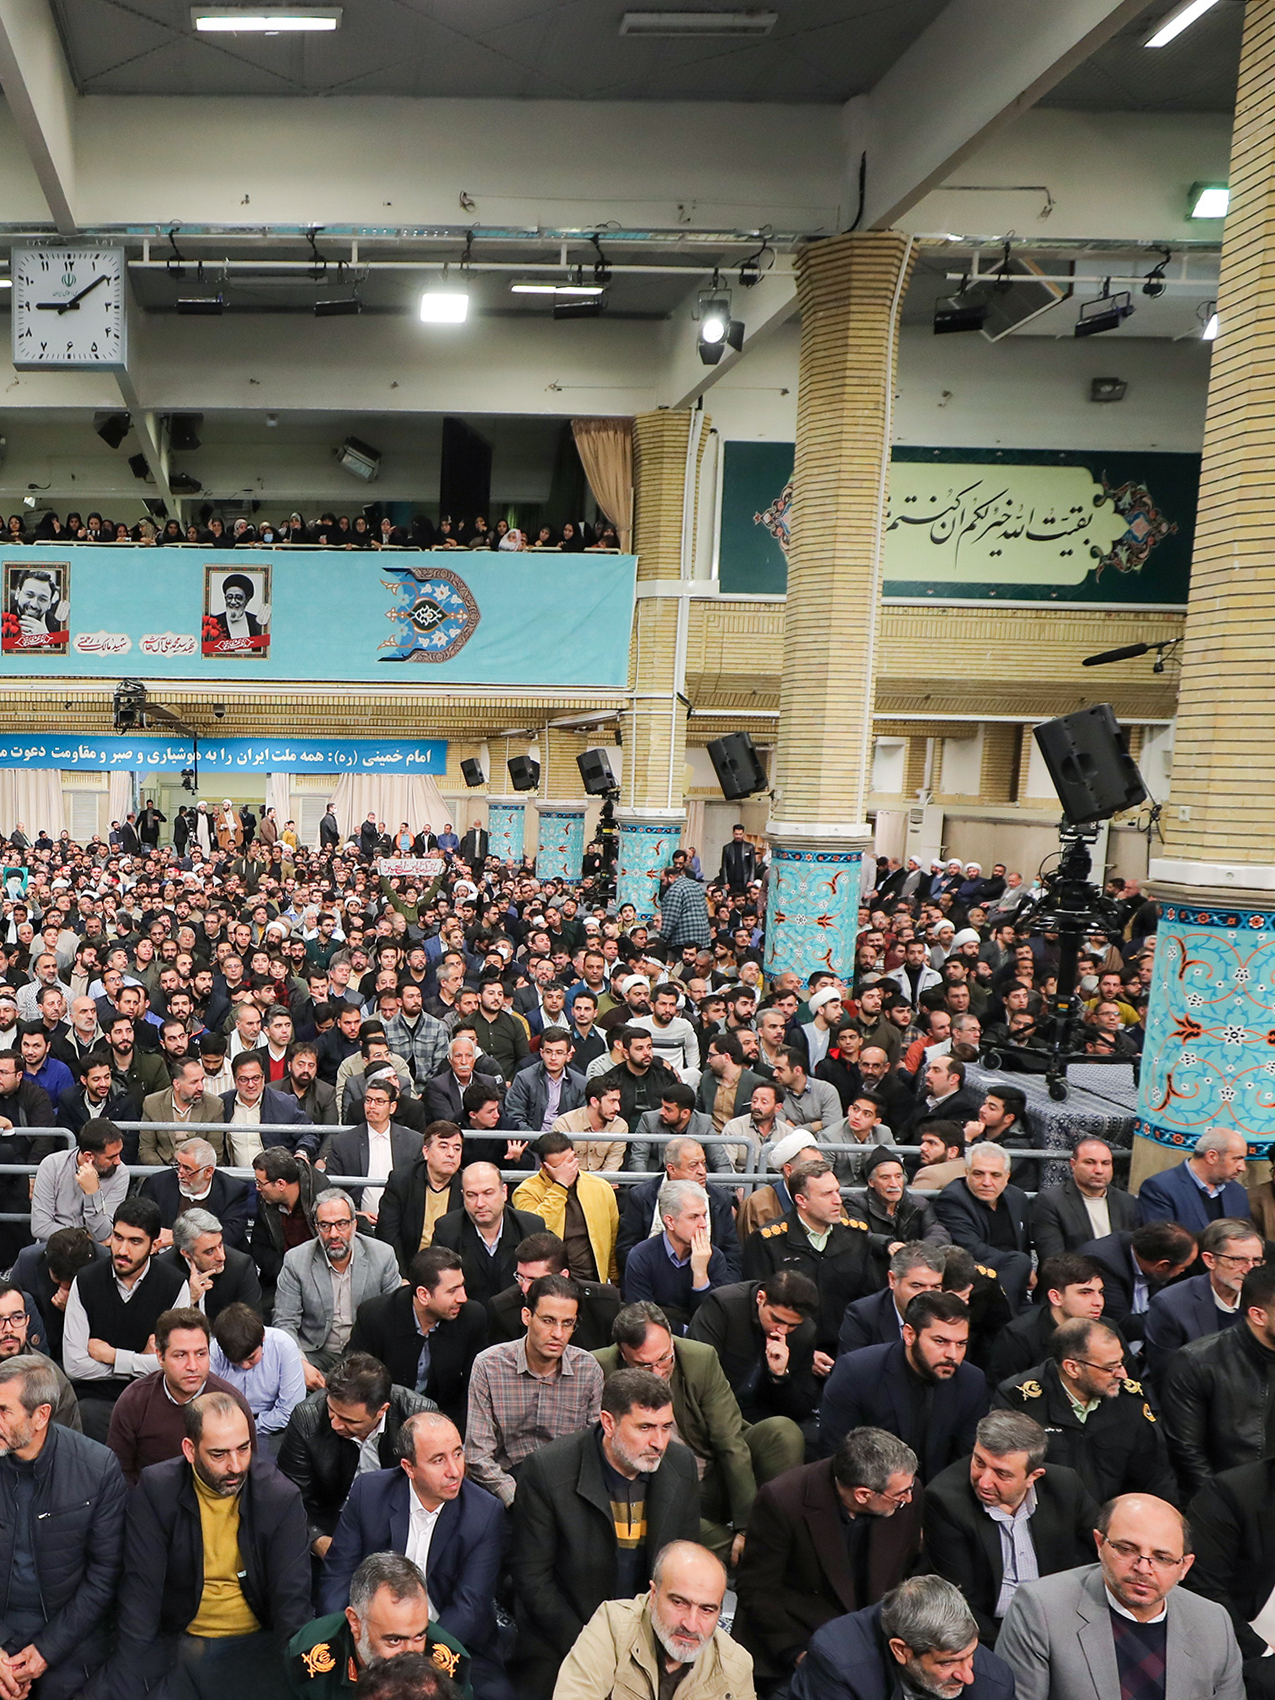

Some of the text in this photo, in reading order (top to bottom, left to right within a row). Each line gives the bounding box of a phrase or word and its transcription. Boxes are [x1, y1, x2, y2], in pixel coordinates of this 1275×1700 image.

[41, 261, 50, 272] ۱۱
[64, 261, 75, 272] ۱۲
[25, 276, 34, 286] ۱۰
[25, 301, 31, 312] ۹
[104, 302, 112, 313] ۳
[25, 327, 33, 338] ۸
[104, 326, 112, 338] ۴
[40, 341, 48, 352] ۷
[66, 341, 74, 352] ۶
[91, 342, 98, 352] ۵
[10, 745, 47, 761] دعوت
[51, 744, 97, 763] مقاومت
[99, 750, 107, 764] و
[110, 749, 134, 764] صبر
[135, 751, 144, 764] و
[204, 749, 217, 765] به
[220, 747, 233, 765] را
[236, 747, 269, 766] ایران
[271, 747, 297, 763] ملت
[299, 750, 325, 763] همه
[362, 748, 404, 768] خمینی
[405, 748, 432, 767] امام
